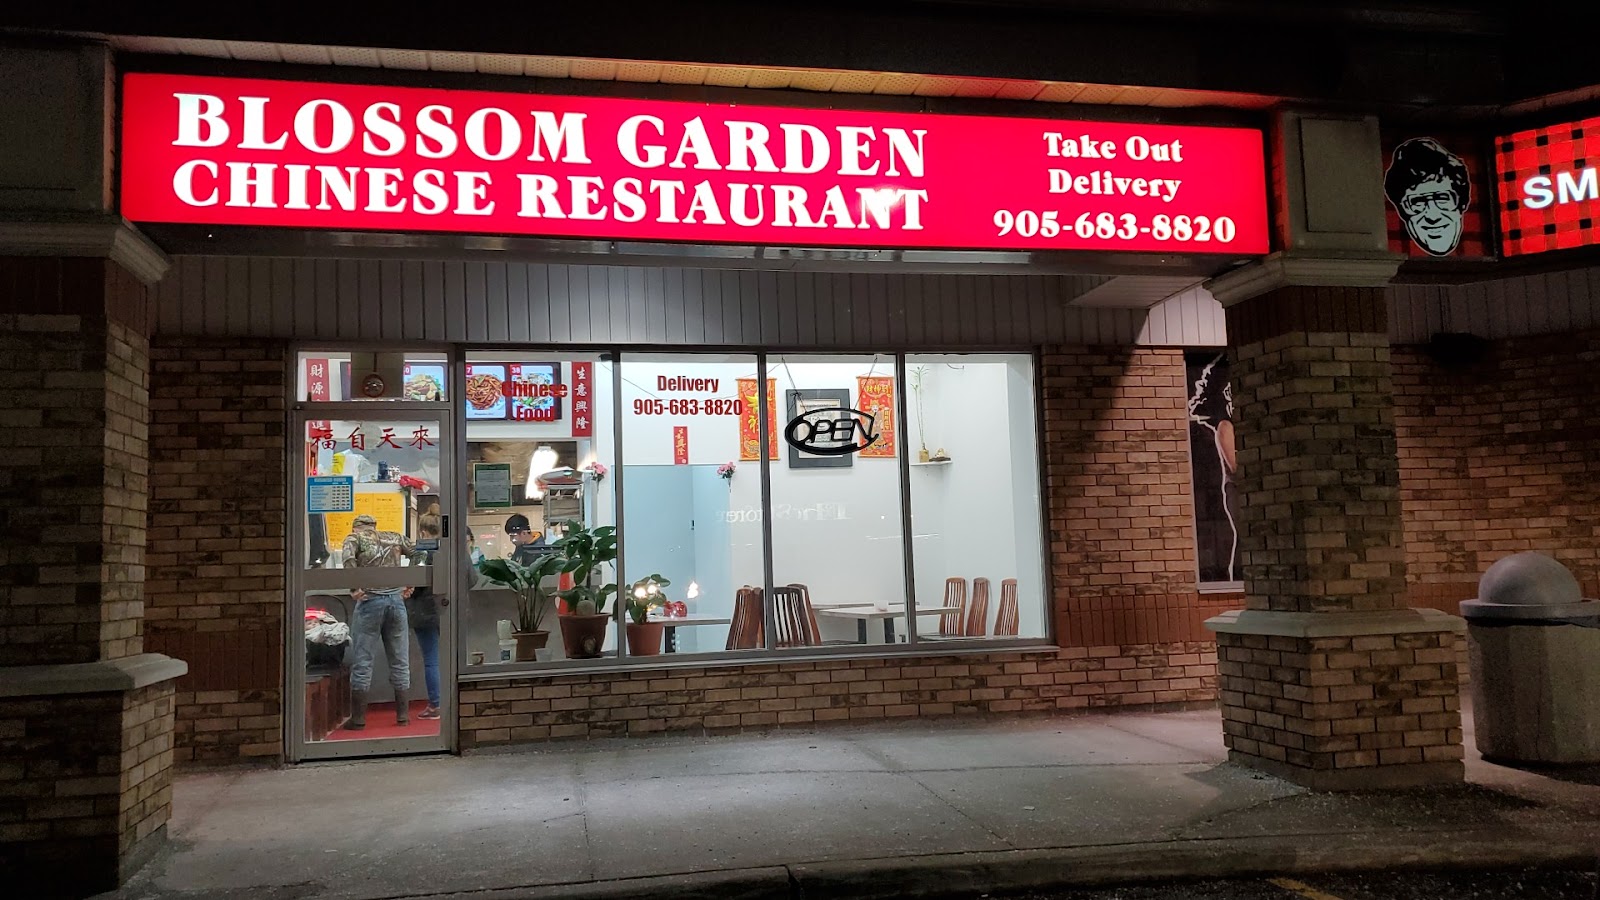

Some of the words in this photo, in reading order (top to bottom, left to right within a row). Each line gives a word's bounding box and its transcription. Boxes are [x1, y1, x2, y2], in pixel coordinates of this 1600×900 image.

[172, 93, 592, 164] BLOSSOM
[616, 114, 928, 178] GARDEN
[1043, 131, 1118, 161] Take
[1125, 135, 1184, 163] Out
[173, 159, 495, 216] CHINESE
[516, 173, 929, 230] RESTAURANT
[1048, 169, 1182, 203] Delivery
[993, 209, 1236, 243] 905-683-8820
[501, 381, 568, 398] Chinese
[574, 366, 589, 430] 生意興隆
[656, 375, 719, 393] Delivery
[516, 405, 556, 422] Food
[633, 398, 743, 416] 905-683-8820
[311, 425, 435, 451] 福自天來
[789, 416, 878, 446] OPEN
